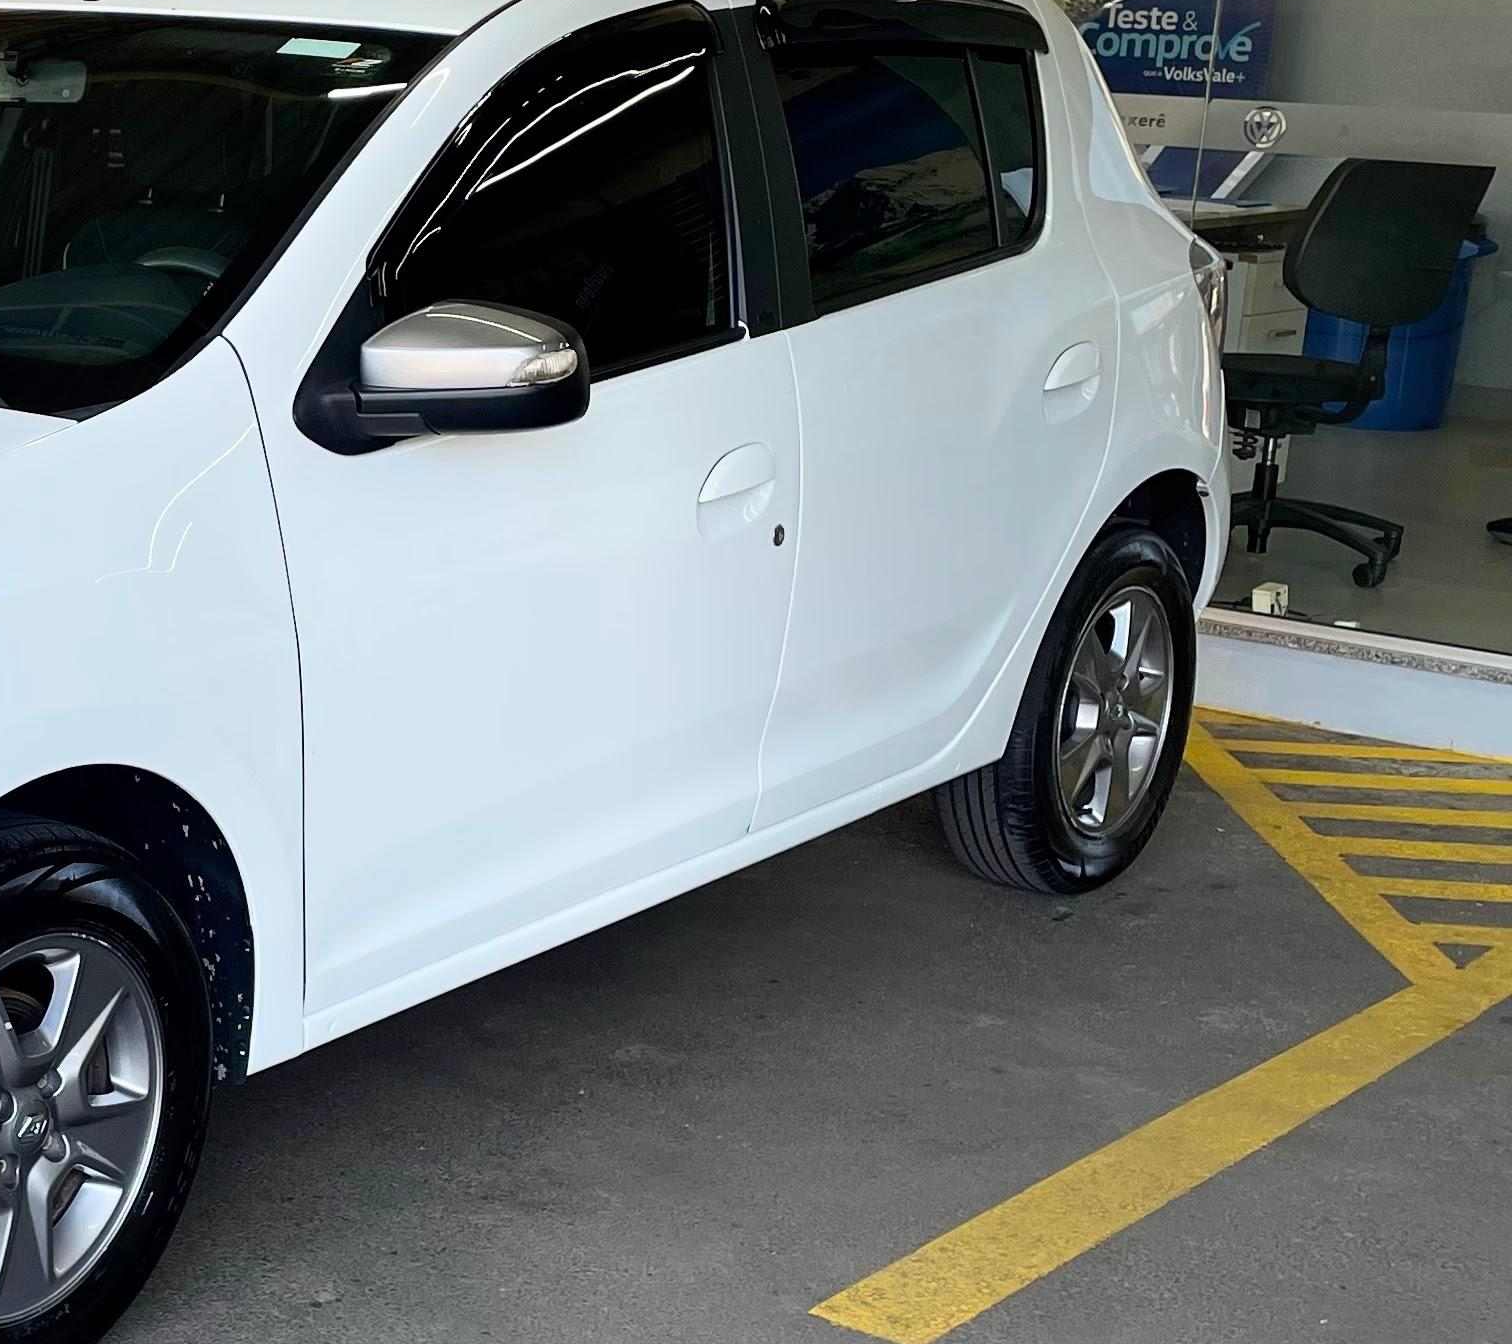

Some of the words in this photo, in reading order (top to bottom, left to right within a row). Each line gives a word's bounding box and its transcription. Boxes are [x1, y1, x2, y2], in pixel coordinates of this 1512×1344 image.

[1105, 3, 1178, 30] Teste
[1182, 10, 1199, 31] &
[1079, 21, 1261, 68] Comprove
[1163, 66, 1246, 83] VolksVale+
